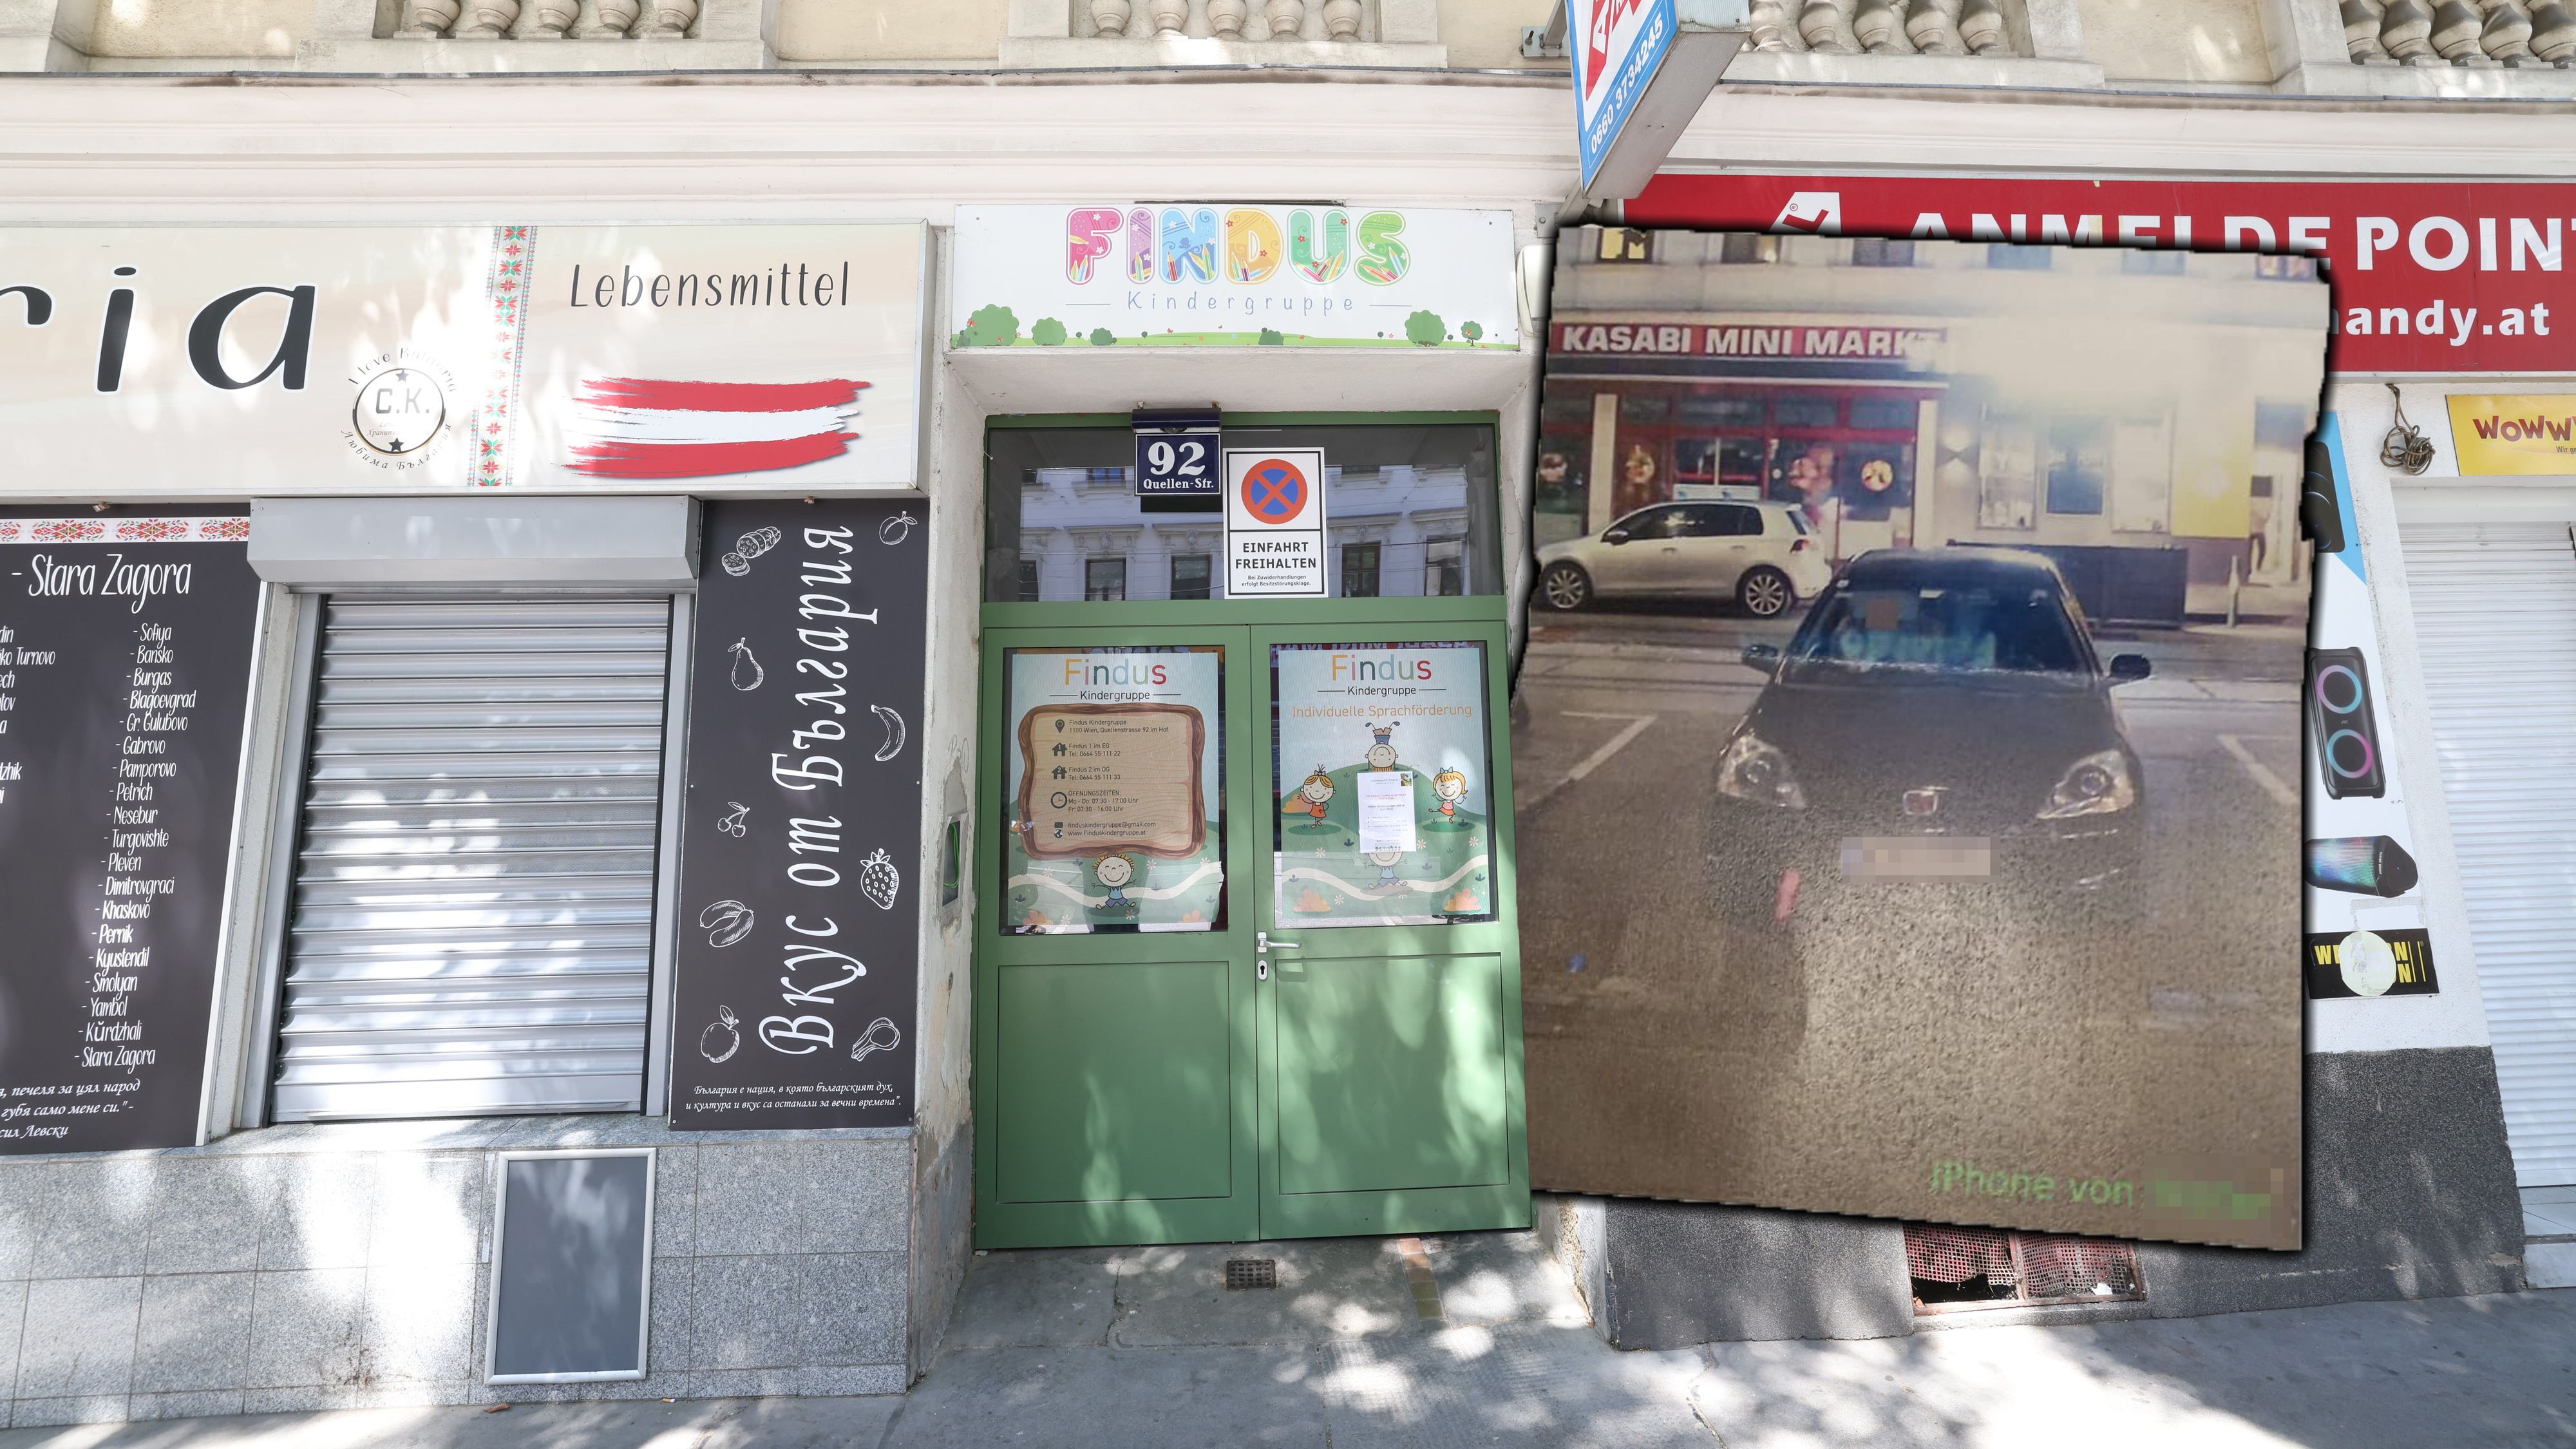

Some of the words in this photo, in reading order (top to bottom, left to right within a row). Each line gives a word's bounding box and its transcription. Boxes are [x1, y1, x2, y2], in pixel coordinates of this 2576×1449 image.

[1591, 104, 1614, 155] 0660
[1615, 12, 1663, 110] 3734245
[1065, 207, 1412, 287] FINDUS
[2356, 216, 2576, 271] POIN
[571, 261, 849, 308] Lebensmittel
[1128, 290, 1354, 316] Kindergruppe
[1562, 327, 1692, 354] KASABI
[1705, 328, 1792, 355] MINI
[358, 353, 390, 375] love
[375, 388, 430, 414] C.K.
[341, 430, 388, 469] Любима
[1148, 441, 1206, 475] 92
[1143, 477, 1214, 489] Quellen-Str.
[1243, 542, 1309, 553] EINFAHRT
[1235, 558, 1316, 569] FREIHALTEN
[28, 554, 97, 596] Stara
[101, 554, 192, 614] Zagora
[140, 623, 172, 649] Sofiya
[17, 647, 55, 665] Turnovo
[137, 645, 174, 664] Bansko
[772, 526, 878, 791] България
[1065, 658, 1167, 686] Findus
[1332, 654, 1432, 681] Findus
[133, 668, 172, 693] Burgas
[1348, 686, 1416, 697] Kindergruppe
[130, 690, 196, 715] Blagoevgrad
[1080, 690, 1150, 701] Kindergruppe
[126, 714, 140, 732] Gr.
[143, 713, 188, 732] Gulubovo
[1293, 706, 1364, 718] Individuelle
[1368, 704, 1472, 719] Sprachförderung
[123, 736, 166, 755] Gabrovo
[119, 759, 176, 786] Pamporovo
[117, 782, 153, 802] Petrich
[113, 806, 158, 825] Nesebur
[112, 829, 169, 857] Turgovishte
[787, 815, 842, 887] от
[108, 853, 141, 871] Pleven
[102, 900, 150, 920] Khaskovo
[99, 924, 134, 944] Pernik
[95, 947, 150, 977] Kyustendil
[92, 972, 138, 1000] Smolyan
[759, 914, 867, 1055] Вкус
[91, 996, 128, 1017] Yambol
[82, 1046, 112, 1068] Stara
[114, 1045, 155, 1074] Zagora
[12, 1084, 55, 1096] печеля
[58, 1084, 73, 1094] за
[77, 1083, 100, 1096] цял
[103, 1078, 140, 1095] народ
[694, 1086, 737, 1096] България
[746, 1086, 775, 1095] нация,
[786, 1084, 814, 1094] която
[817, 1083, 874, 1094] българският
[1, 1103, 31, 1121] губя
[33, 1105, 66, 1116] само
[68, 1104, 100, 1114] мене
[694, 1101, 731, 1112] култура
[742, 1101, 760, 1112] вкус
[20, 1124, 70, 1139] Левски
